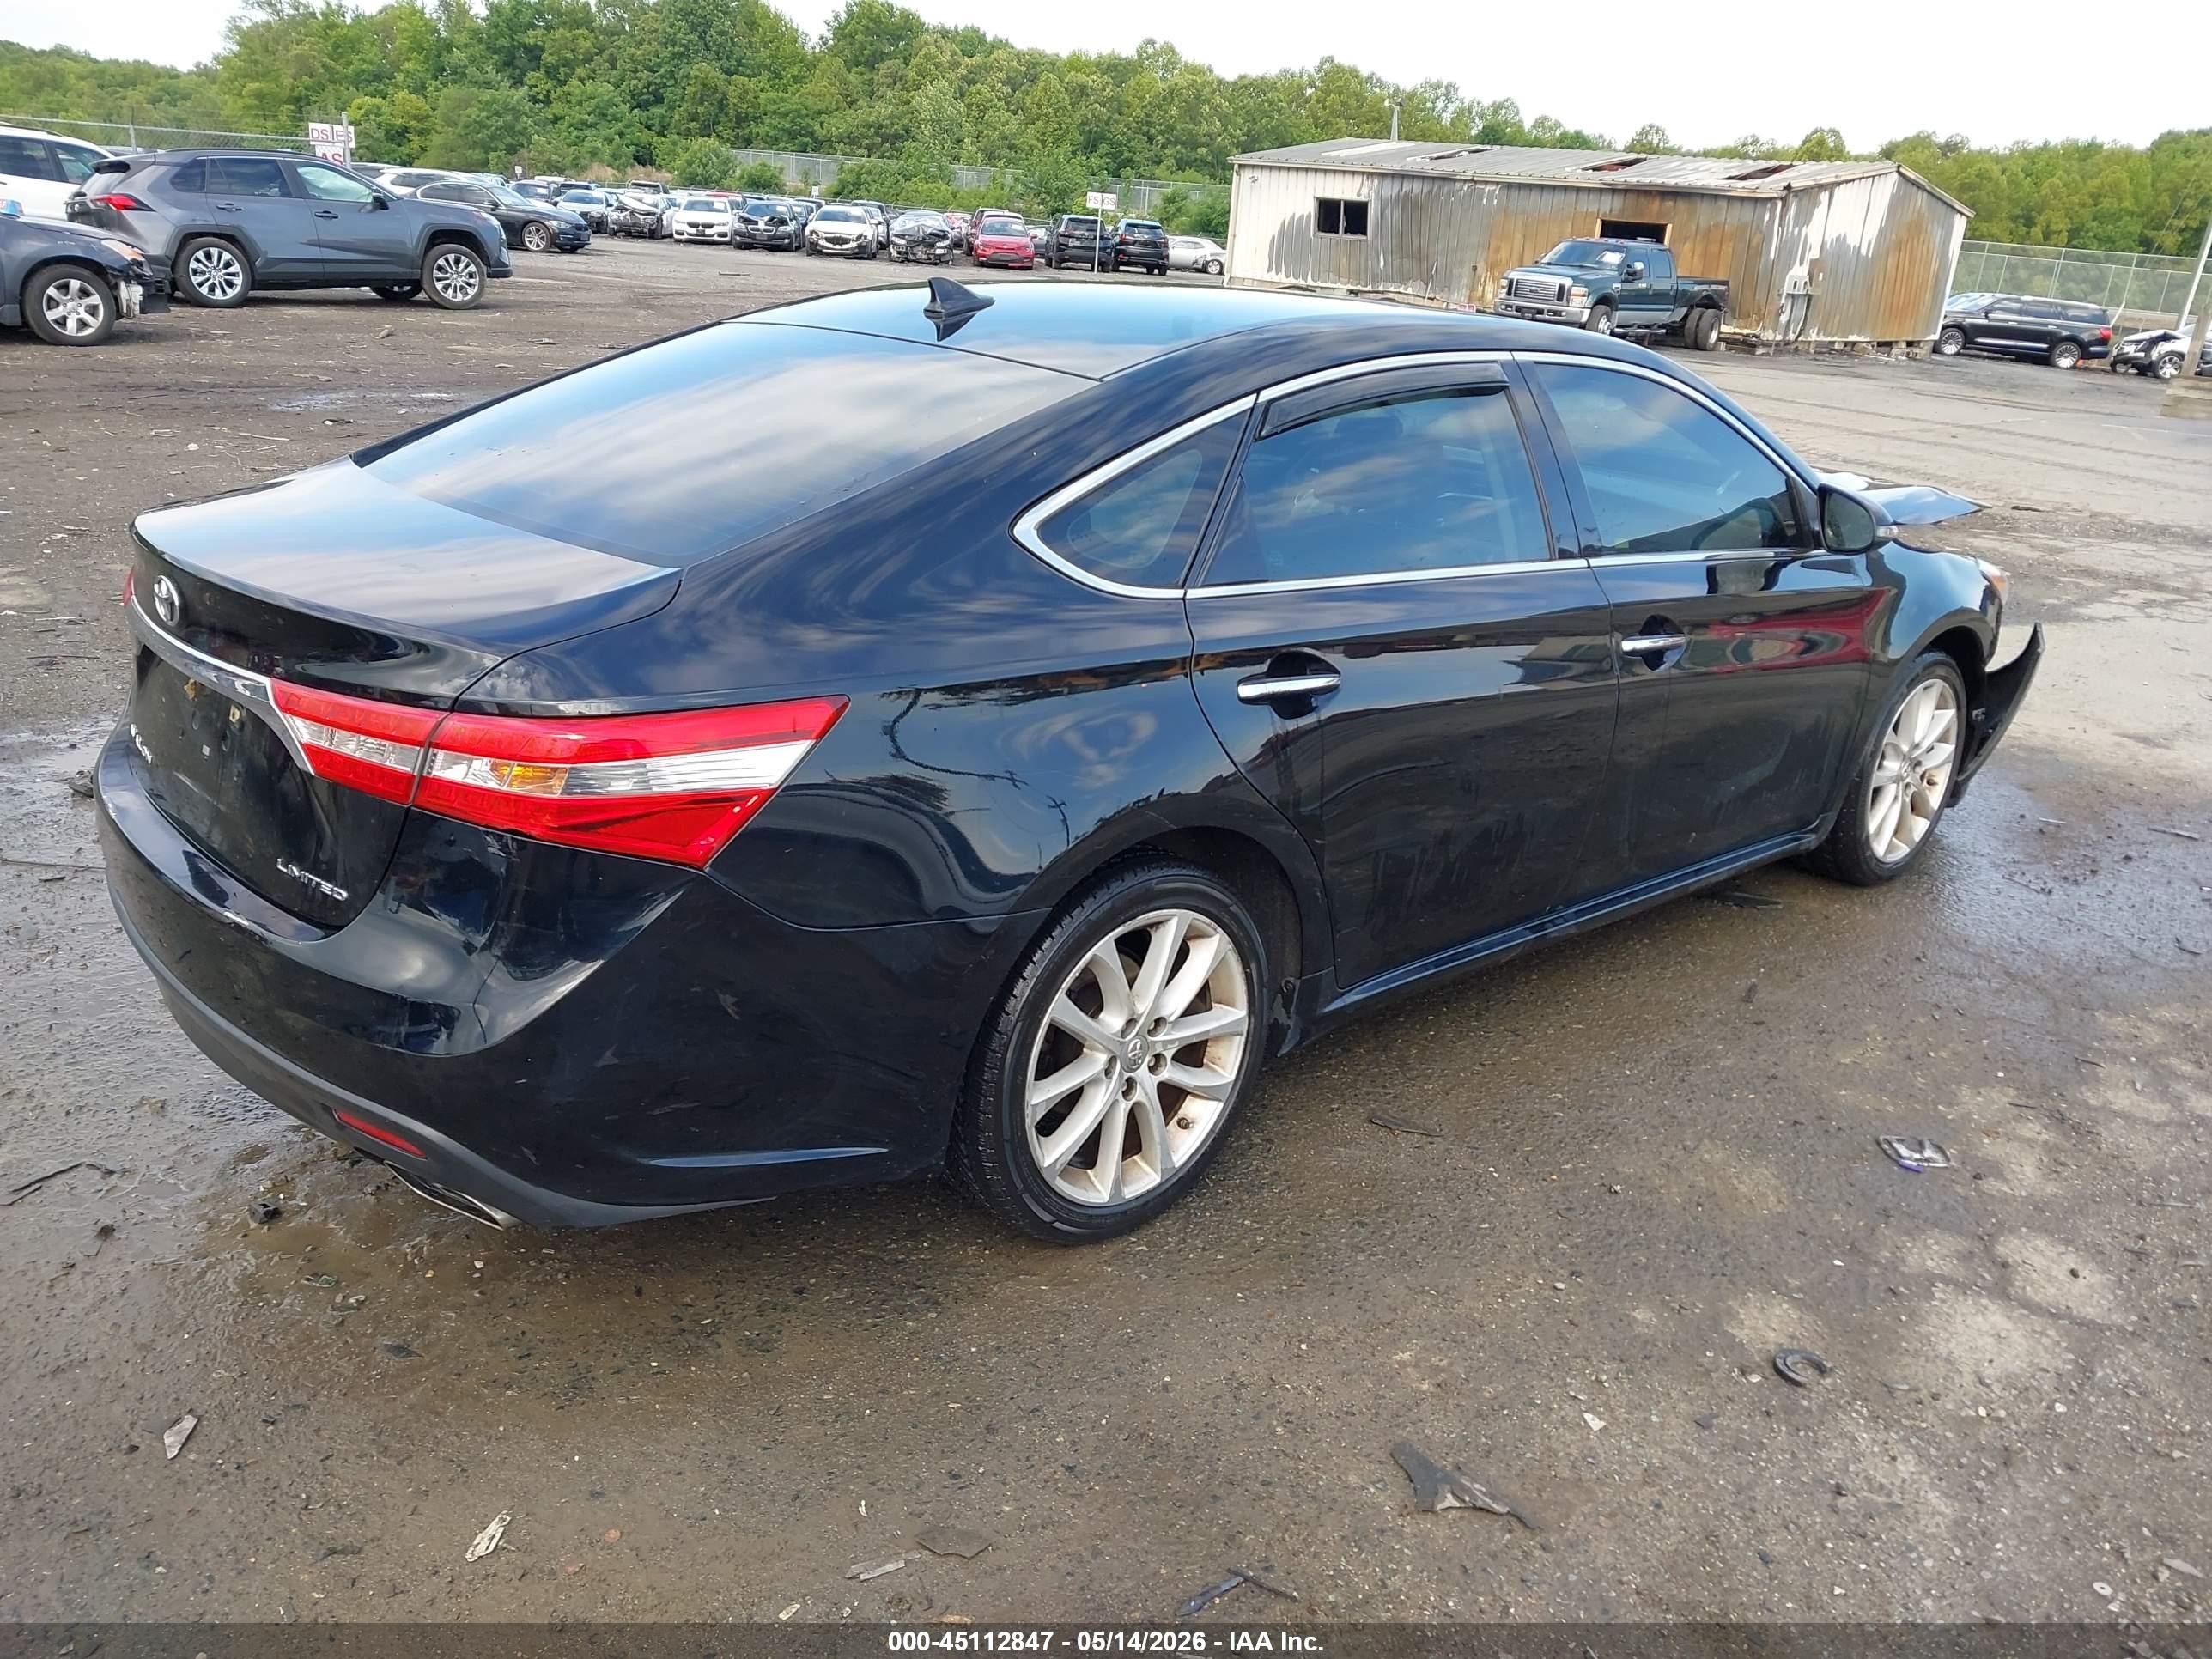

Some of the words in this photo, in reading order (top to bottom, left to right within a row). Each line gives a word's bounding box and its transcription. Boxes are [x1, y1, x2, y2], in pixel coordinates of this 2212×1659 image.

[310, 128, 329, 140] DS
[1088, 196, 1099, 204] FS
[1103, 197, 1115, 206] GS
[276, 858, 348, 902] LIMITED
